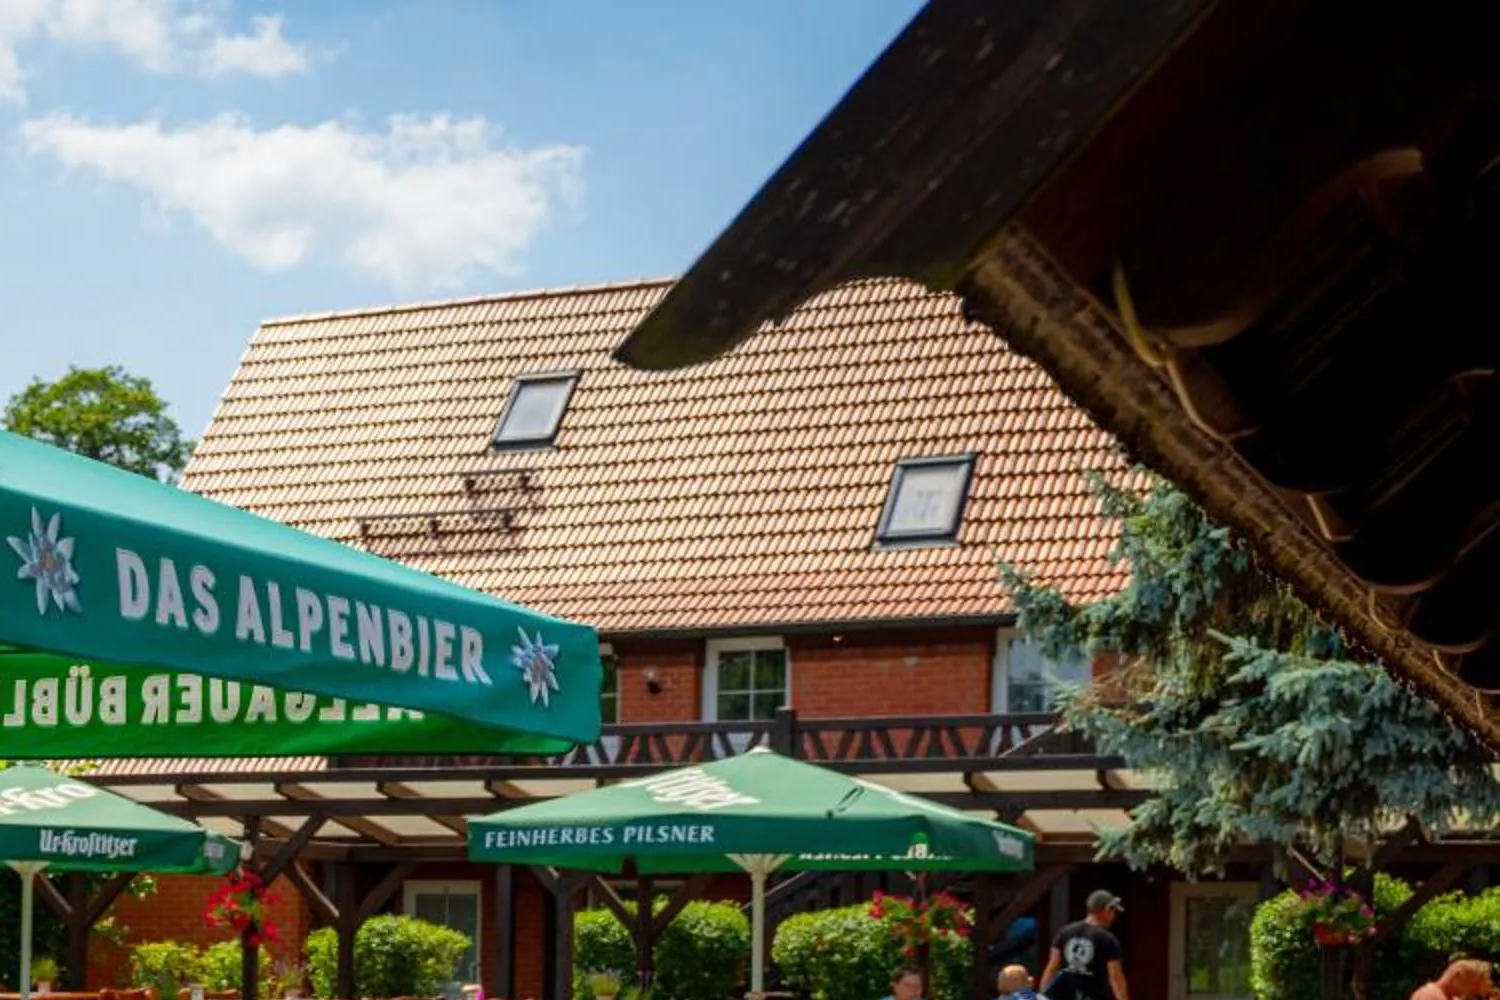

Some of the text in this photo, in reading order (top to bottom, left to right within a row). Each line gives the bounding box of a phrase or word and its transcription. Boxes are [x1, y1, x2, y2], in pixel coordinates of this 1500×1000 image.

[115, 547, 493, 686] DAS ALPENBIER
[484, 824, 715, 849] FEINHERBES PILSNER
